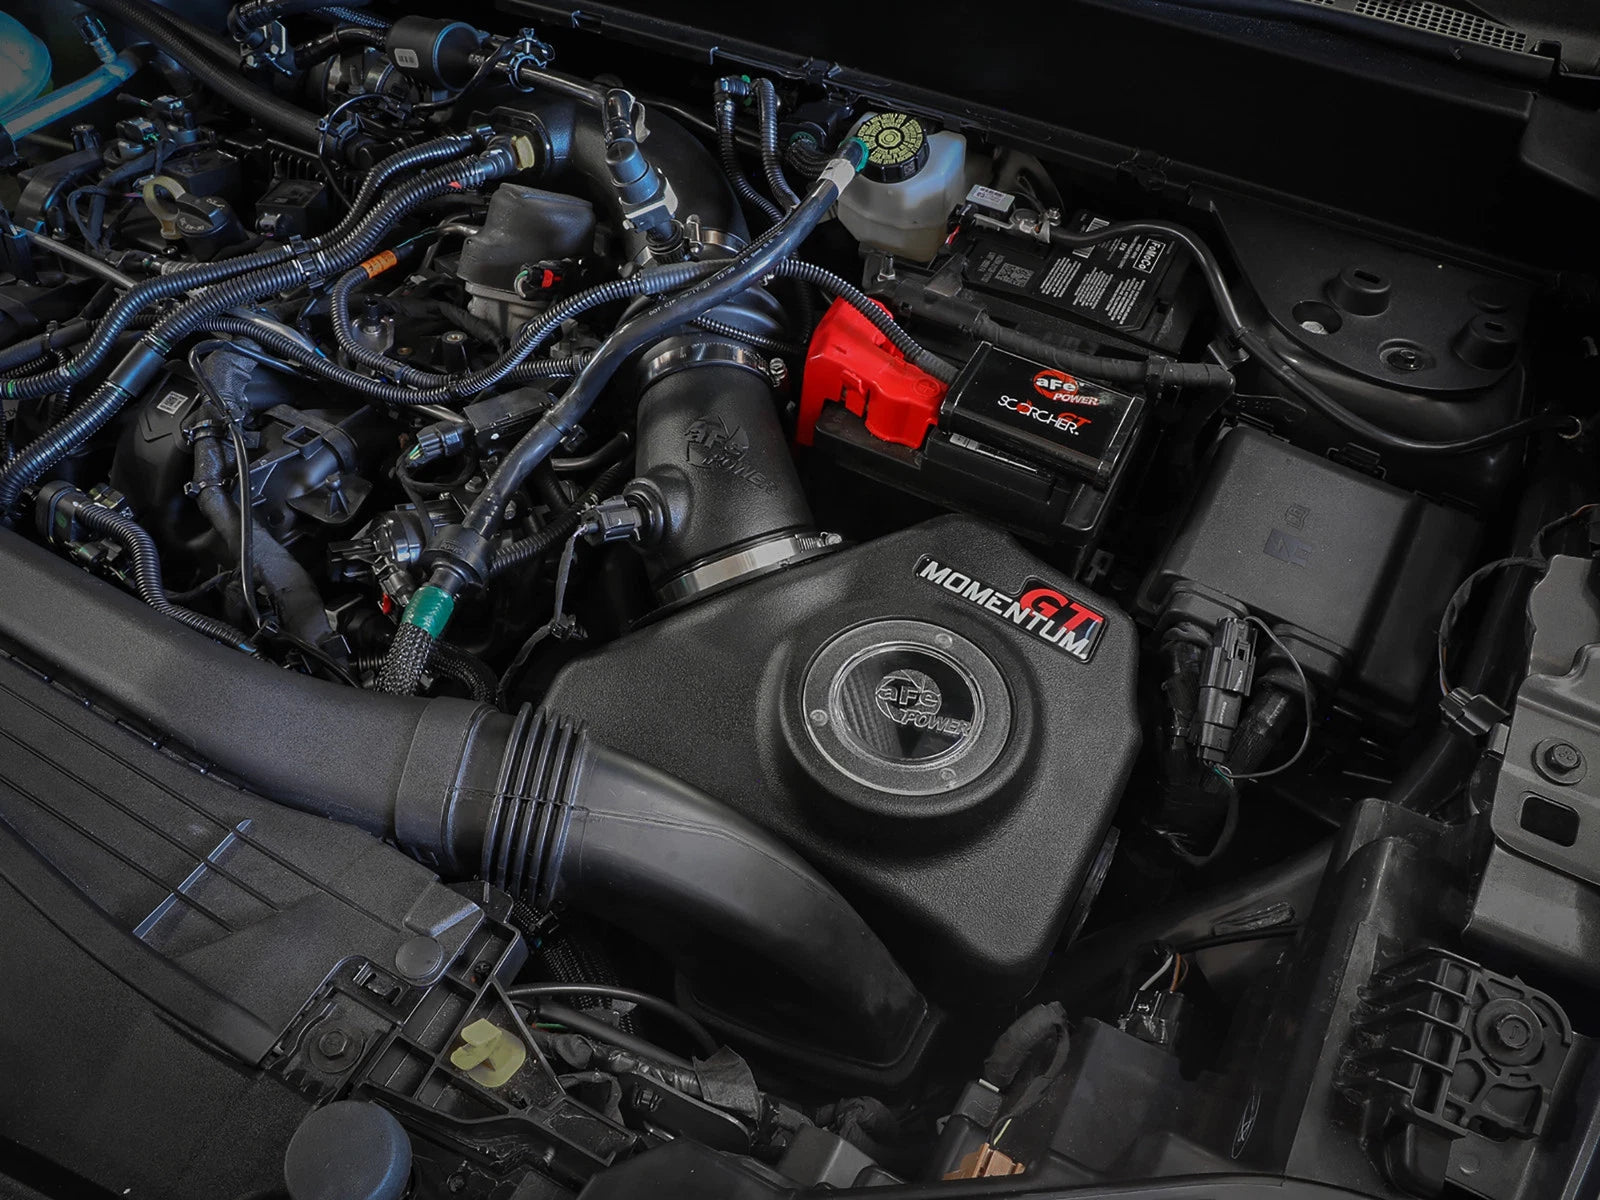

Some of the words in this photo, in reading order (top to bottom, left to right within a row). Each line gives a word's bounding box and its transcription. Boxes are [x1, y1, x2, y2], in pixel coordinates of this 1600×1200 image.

[1138, 240, 1161, 270] FoMoCo
[1053, 392, 1100, 406] POWER
[920, 560, 1092, 660] MOMENTUM
[1019, 588, 1105, 635] GT
[900, 711, 971, 737] POWER
